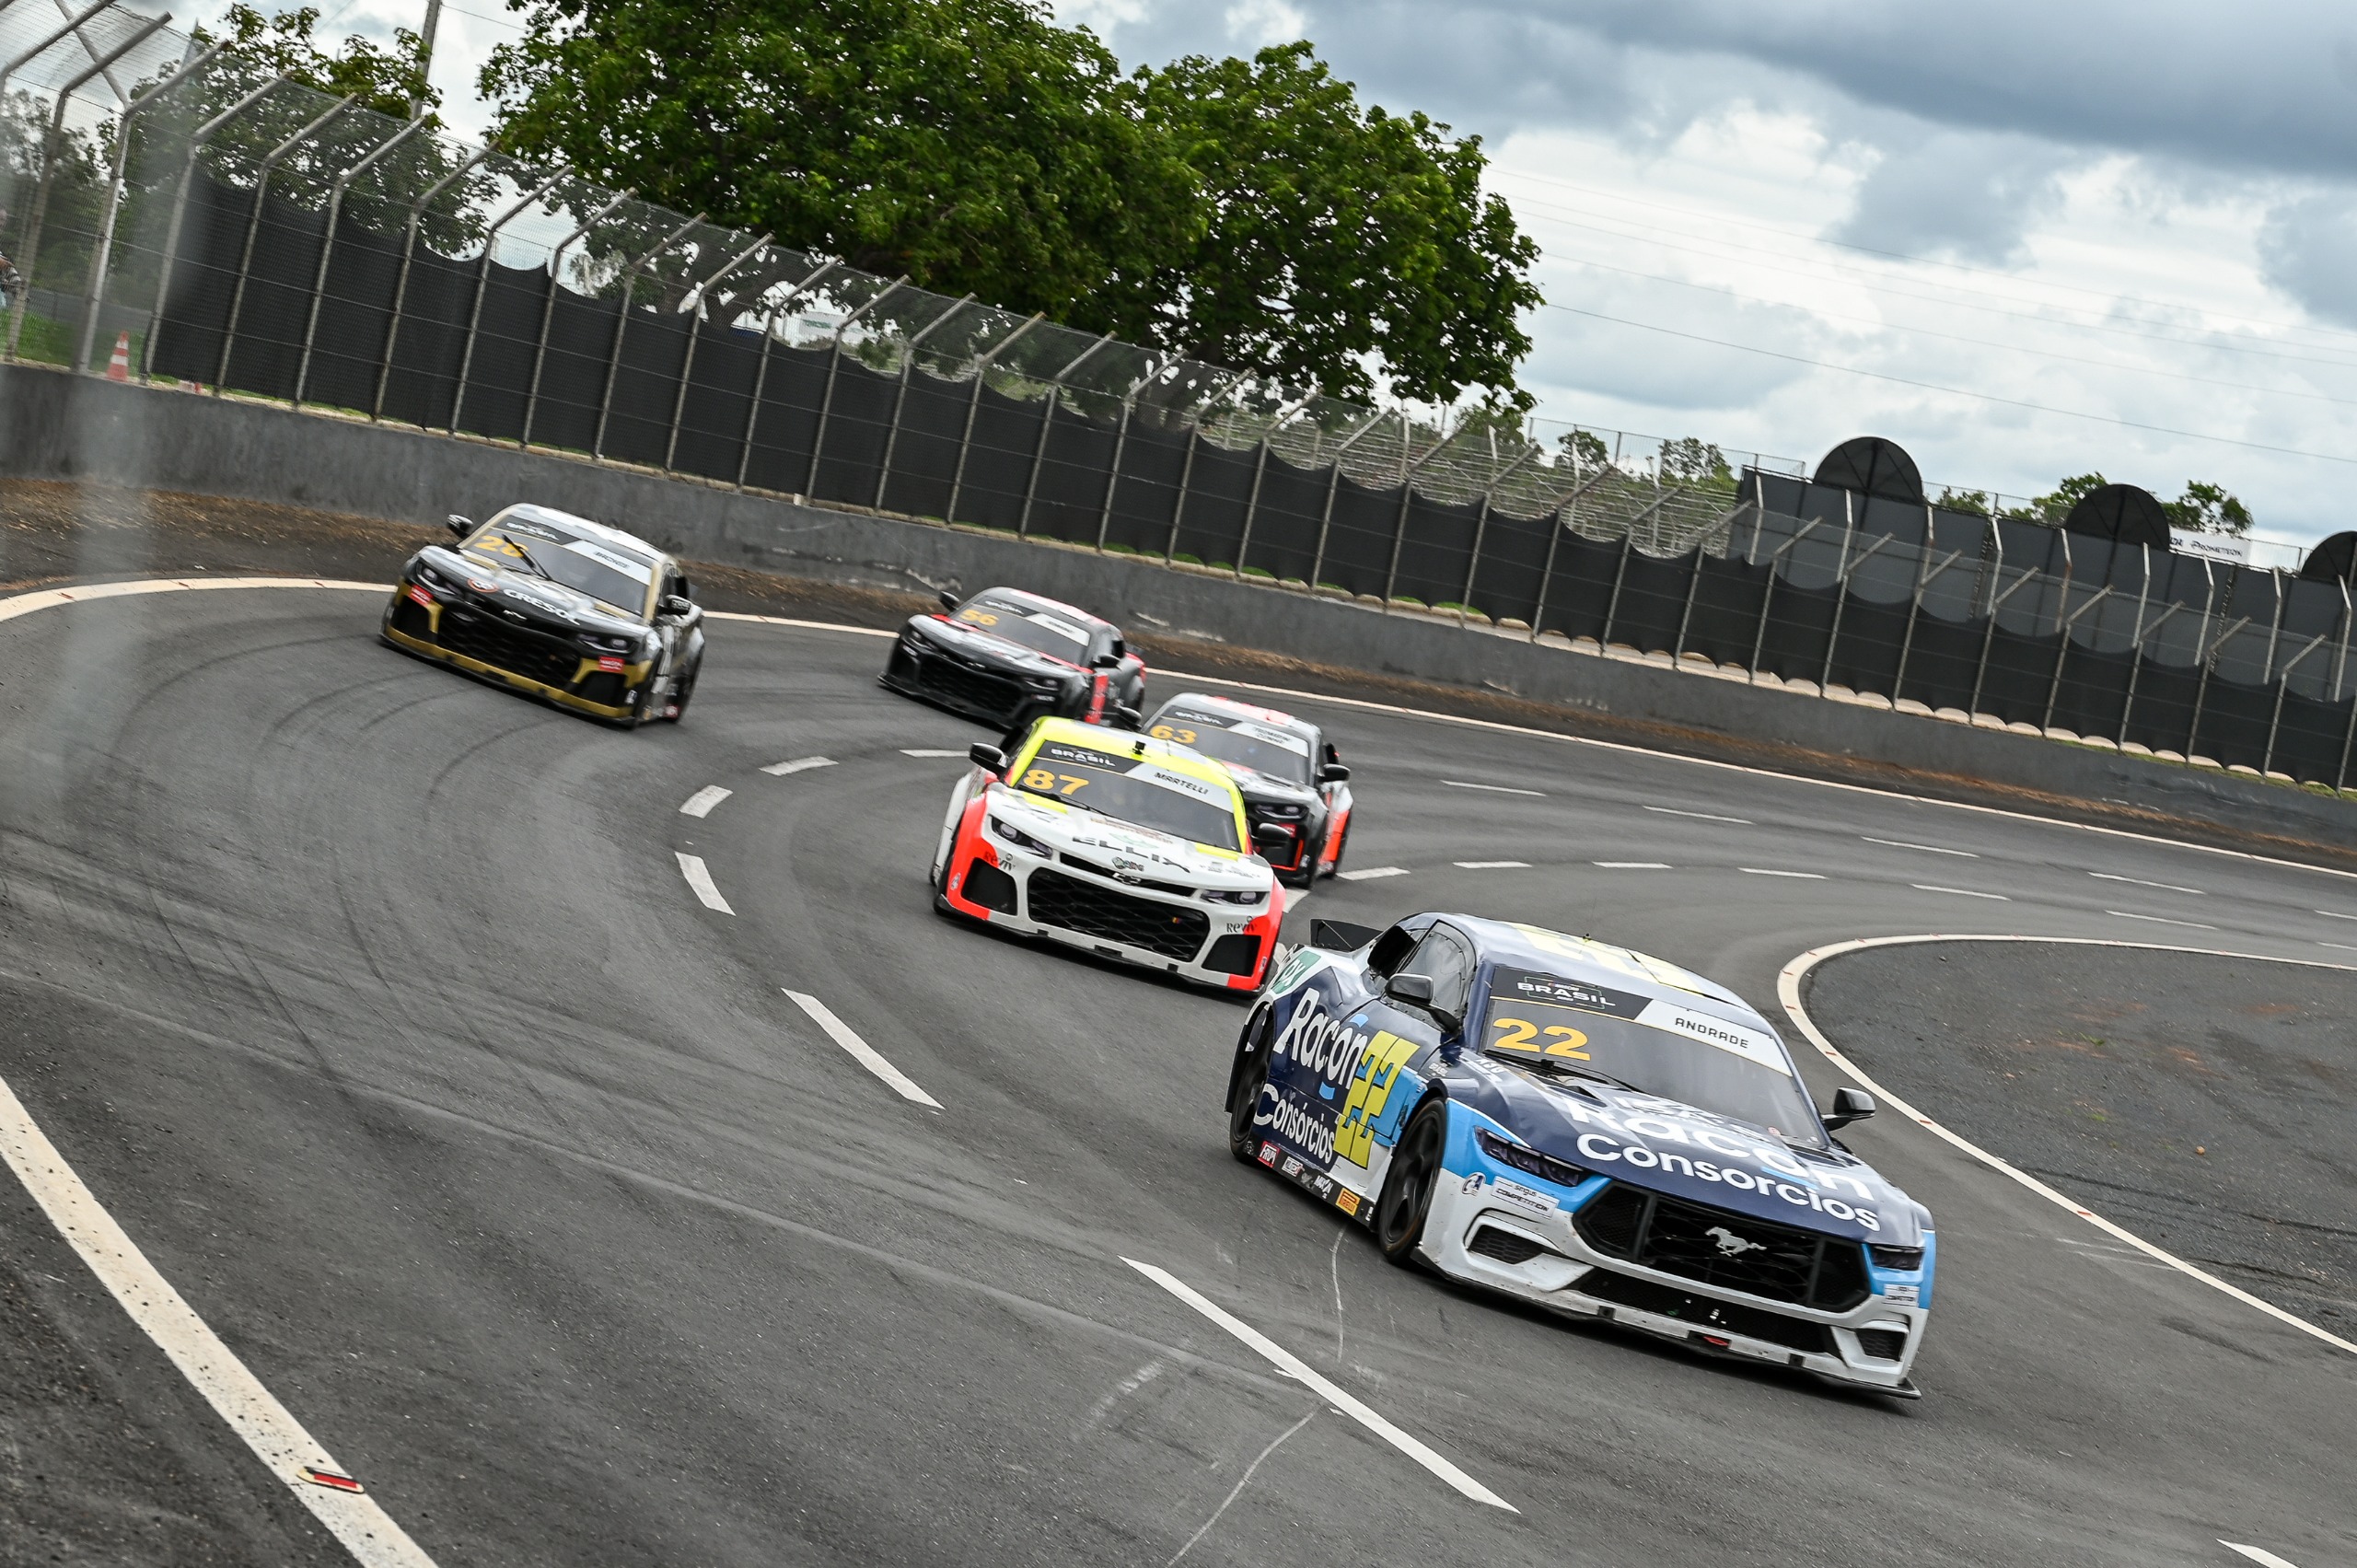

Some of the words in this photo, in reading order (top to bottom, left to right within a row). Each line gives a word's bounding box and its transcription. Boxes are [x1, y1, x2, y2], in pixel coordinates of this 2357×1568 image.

[504, 589, 580, 625] CRESOL
[959, 609, 999, 626] 56
[1151, 725, 1197, 744] 63
[1051, 747, 1116, 767] BRASIL
[1023, 769, 1089, 796] 87
[1154, 772, 1209, 795] MARTELLI
[1516, 981, 1616, 1006] BRASIL
[1272, 987, 1368, 1090] Racon
[1492, 1017, 1591, 1061] 22
[1675, 1017, 1748, 1049] ANDRADE
[1252, 1083, 1335, 1165] Consórcios
[1576, 1133, 1881, 1232] Consorcios
